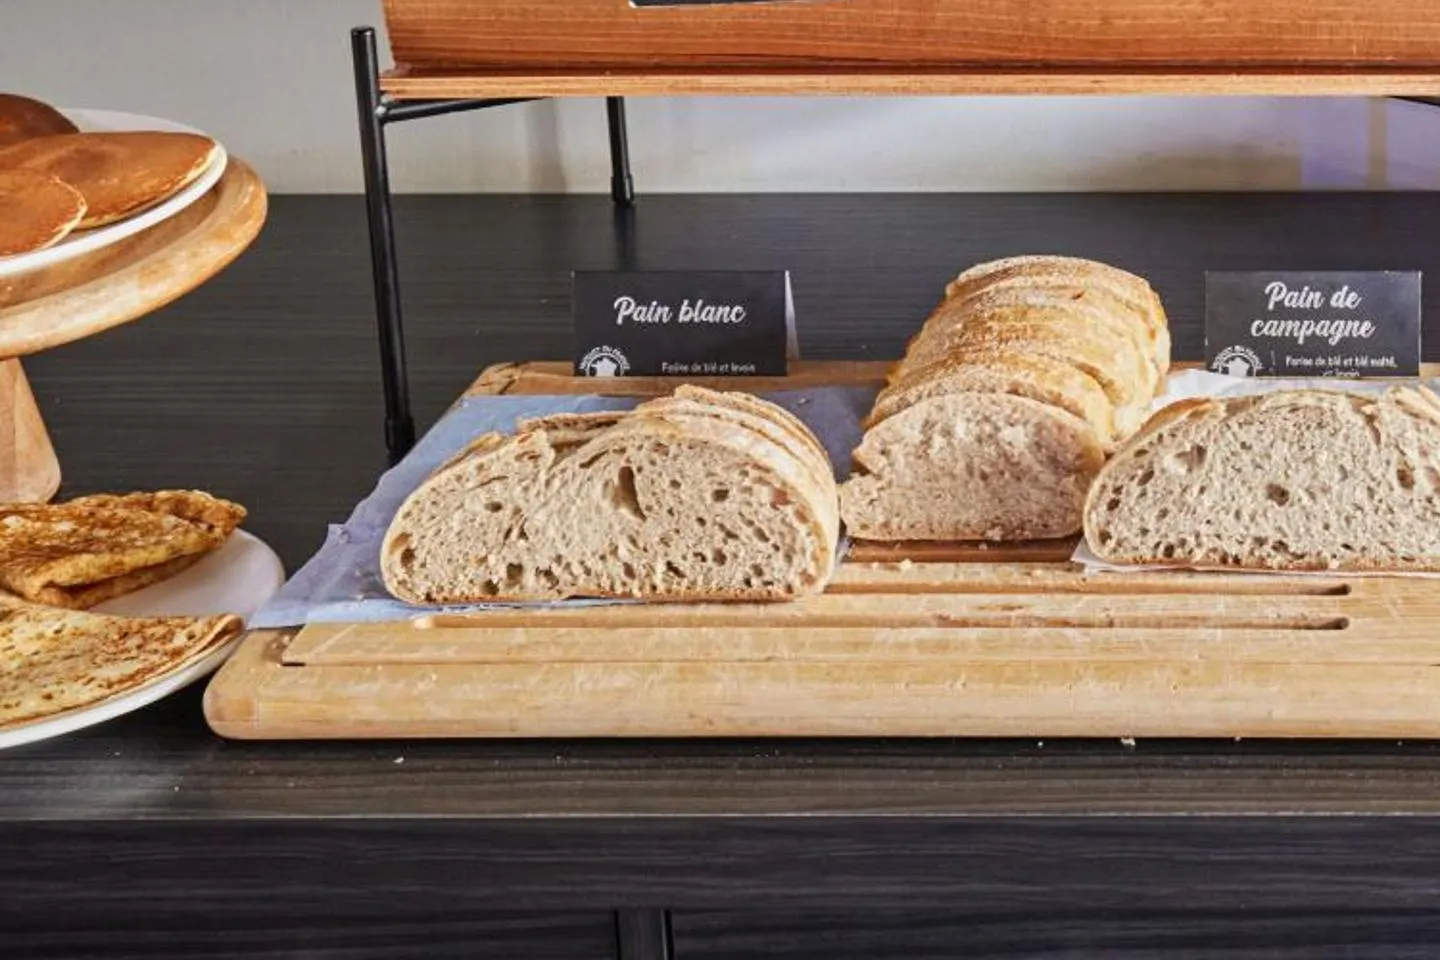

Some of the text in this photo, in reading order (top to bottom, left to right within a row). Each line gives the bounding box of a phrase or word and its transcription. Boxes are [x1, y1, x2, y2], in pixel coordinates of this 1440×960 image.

[614, 296, 747, 325] Pain blanc
[1264, 281, 1363, 311] Pain de
[1250, 317, 1376, 346] campagne
